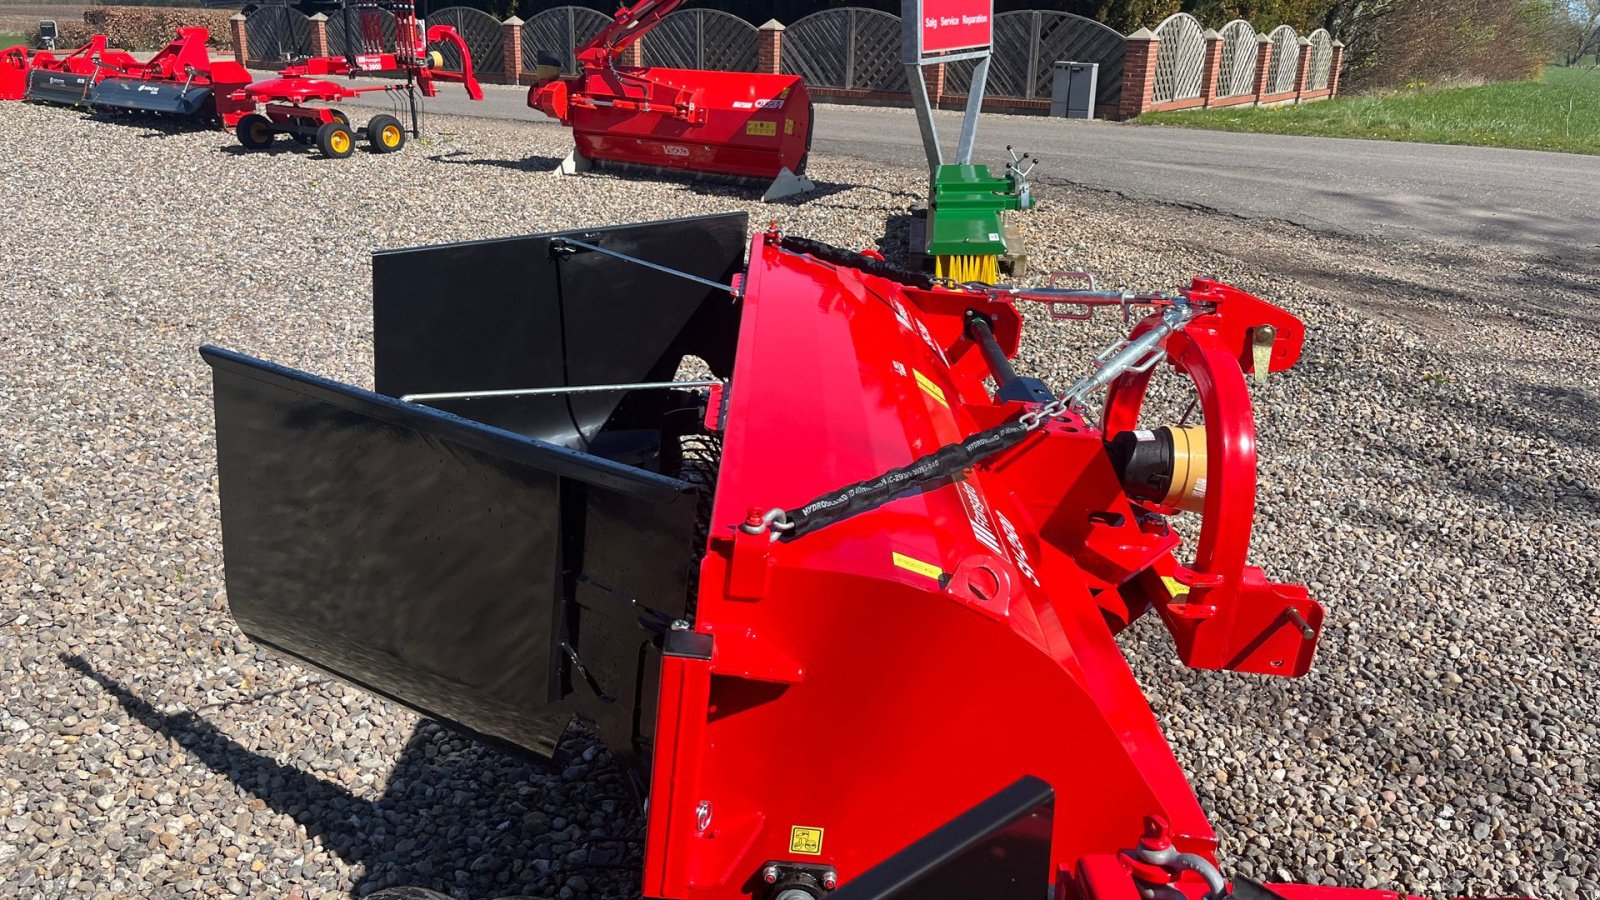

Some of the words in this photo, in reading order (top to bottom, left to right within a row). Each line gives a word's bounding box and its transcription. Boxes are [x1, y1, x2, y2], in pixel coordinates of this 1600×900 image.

[925, 17, 937, 29] Salg
[940, 16, 959, 26] Service
[962, 14, 987, 26] Reparation
